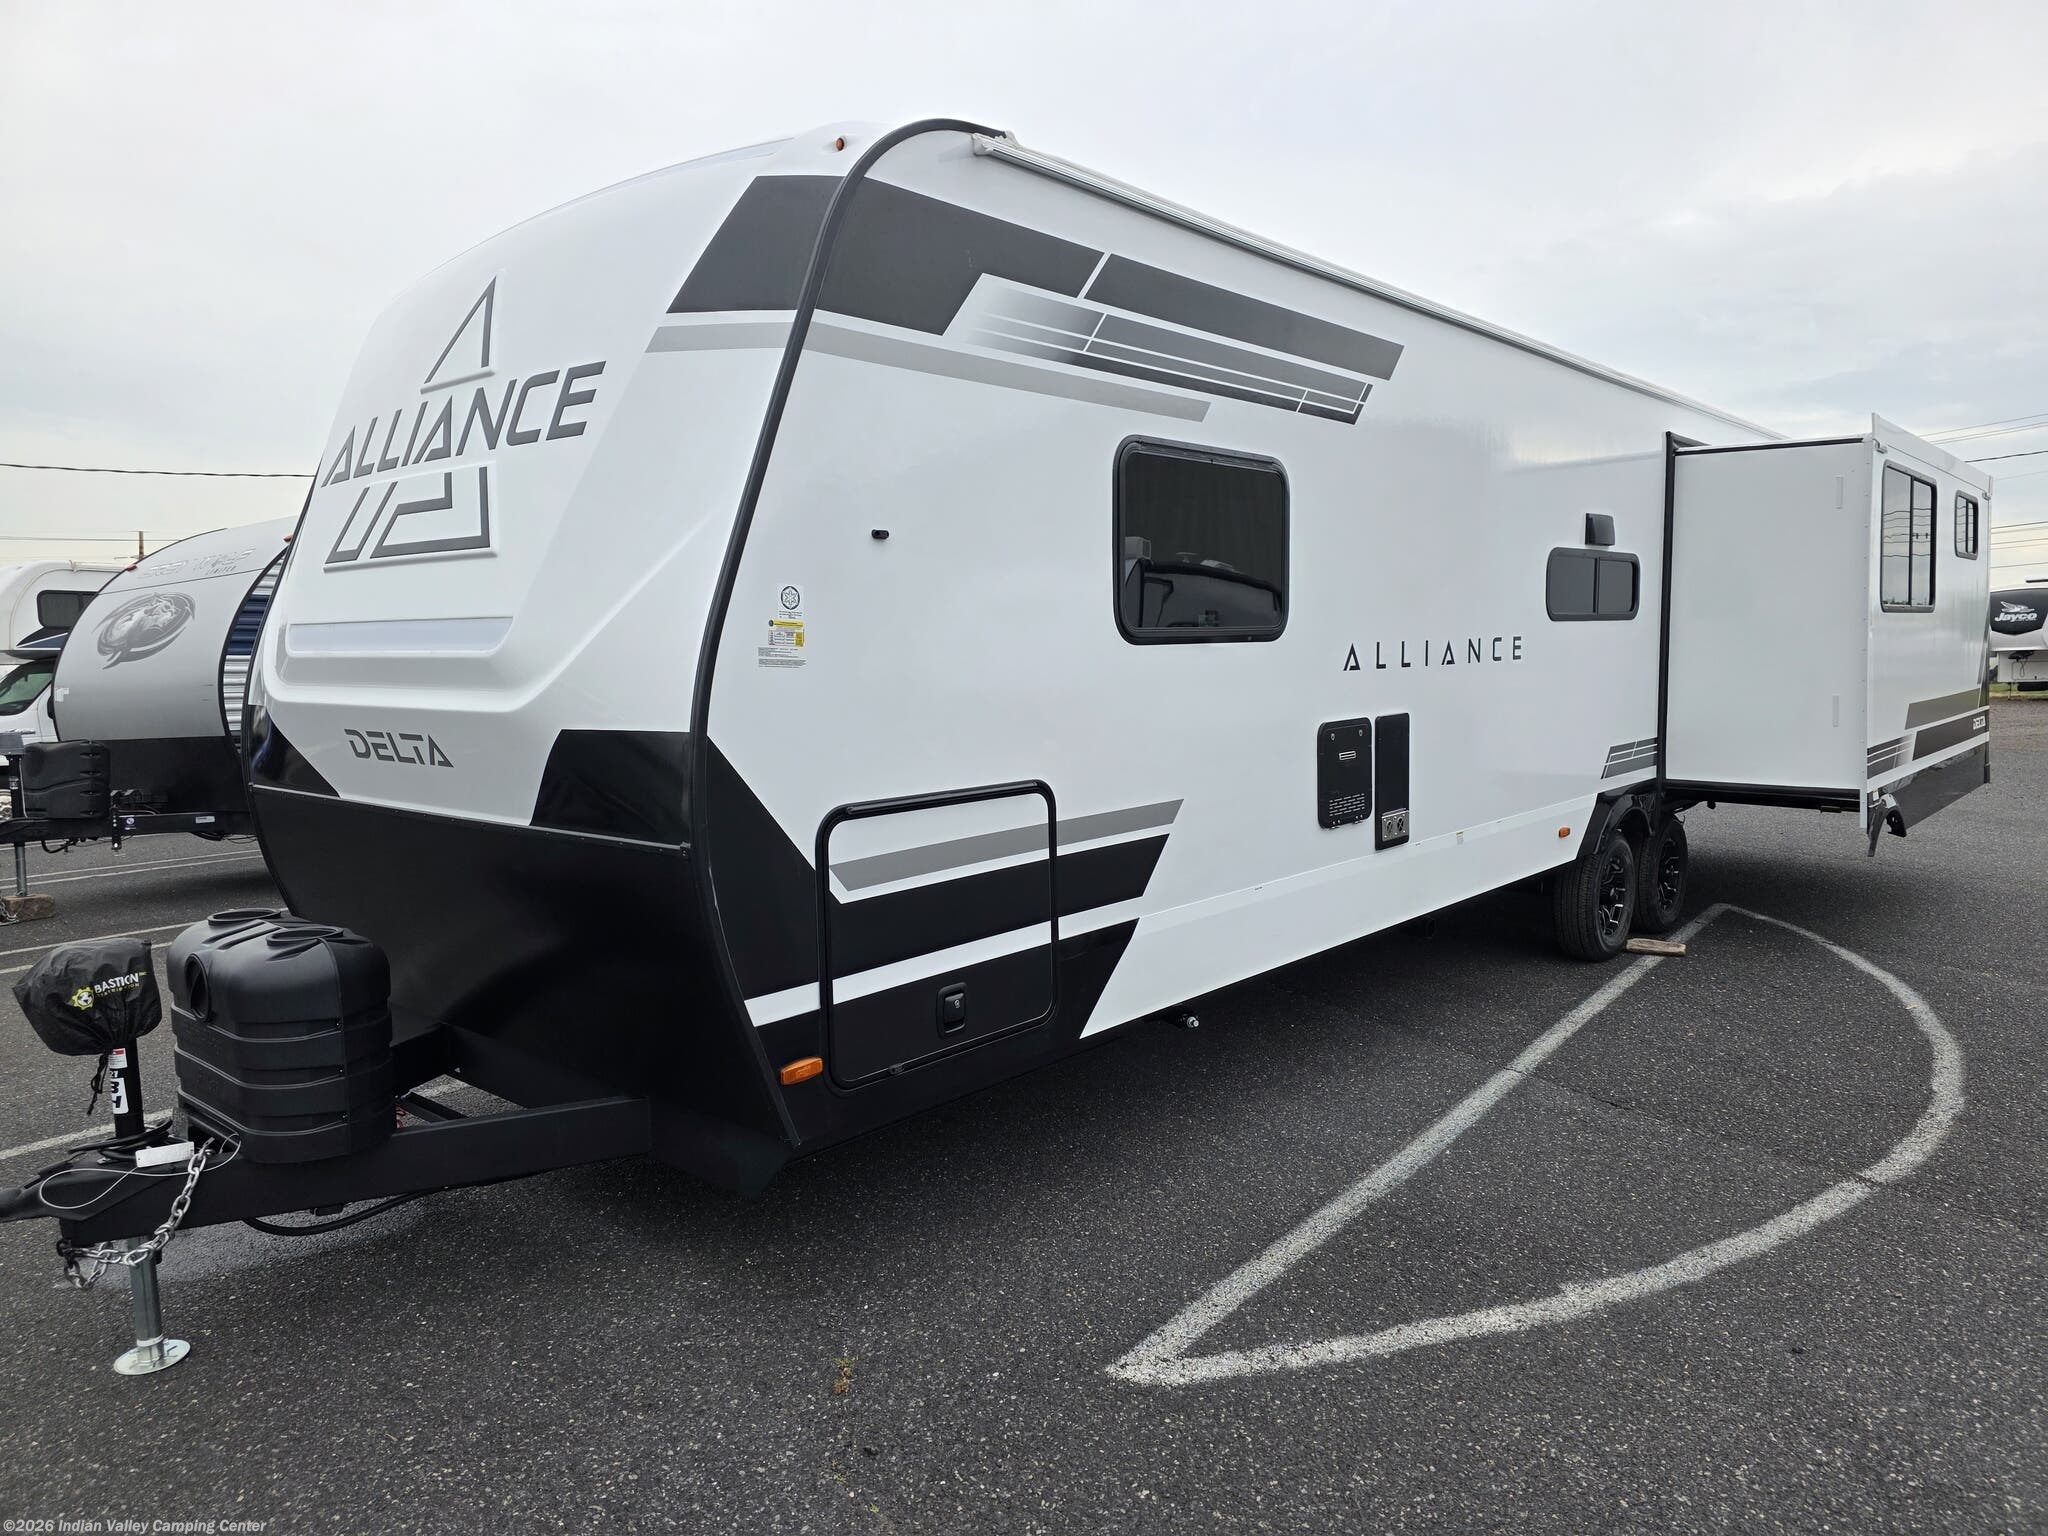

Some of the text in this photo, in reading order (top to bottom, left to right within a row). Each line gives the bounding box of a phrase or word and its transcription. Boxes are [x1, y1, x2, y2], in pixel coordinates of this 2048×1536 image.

[320, 360, 607, 488] ALLIANCE
[1994, 612, 2038, 623] Jayco
[1343, 636, 1522, 671] ALLIANCE
[344, 728, 455, 768] DELTA
